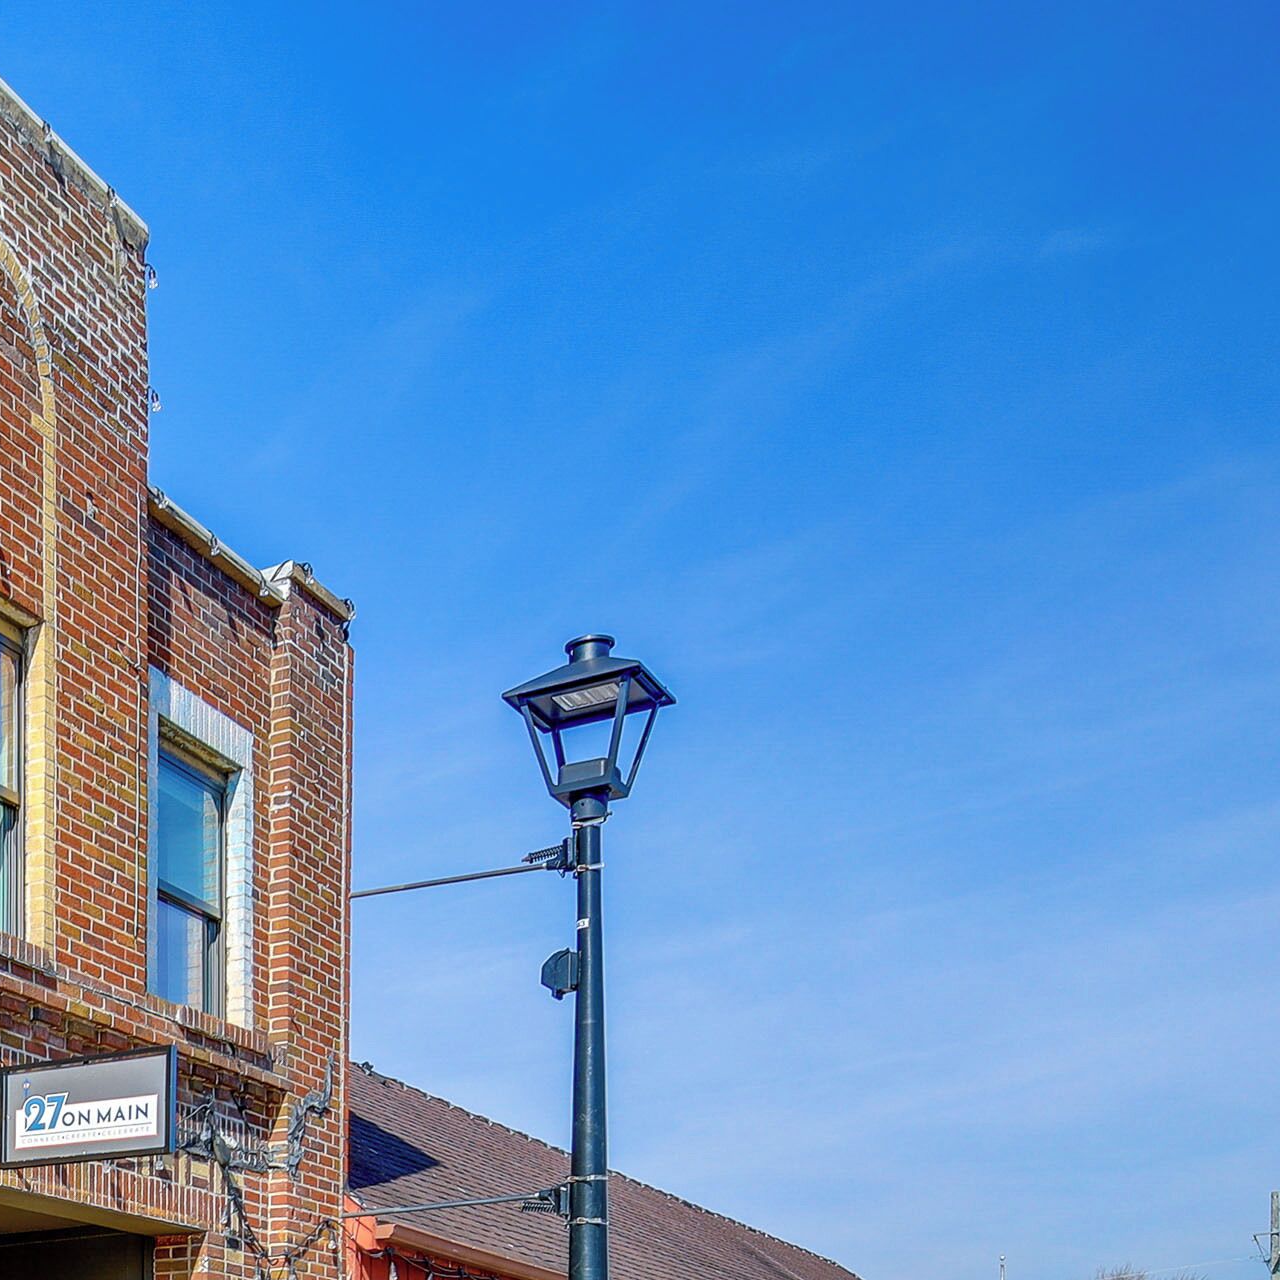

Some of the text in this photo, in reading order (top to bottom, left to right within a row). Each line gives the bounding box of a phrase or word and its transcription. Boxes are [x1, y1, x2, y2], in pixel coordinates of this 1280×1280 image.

[23, 1095, 149, 1133] 27 ON MAIN
[21, 1136, 62, 1145] CONNECT
[101, 1126, 150, 1137] CELEBRATE
